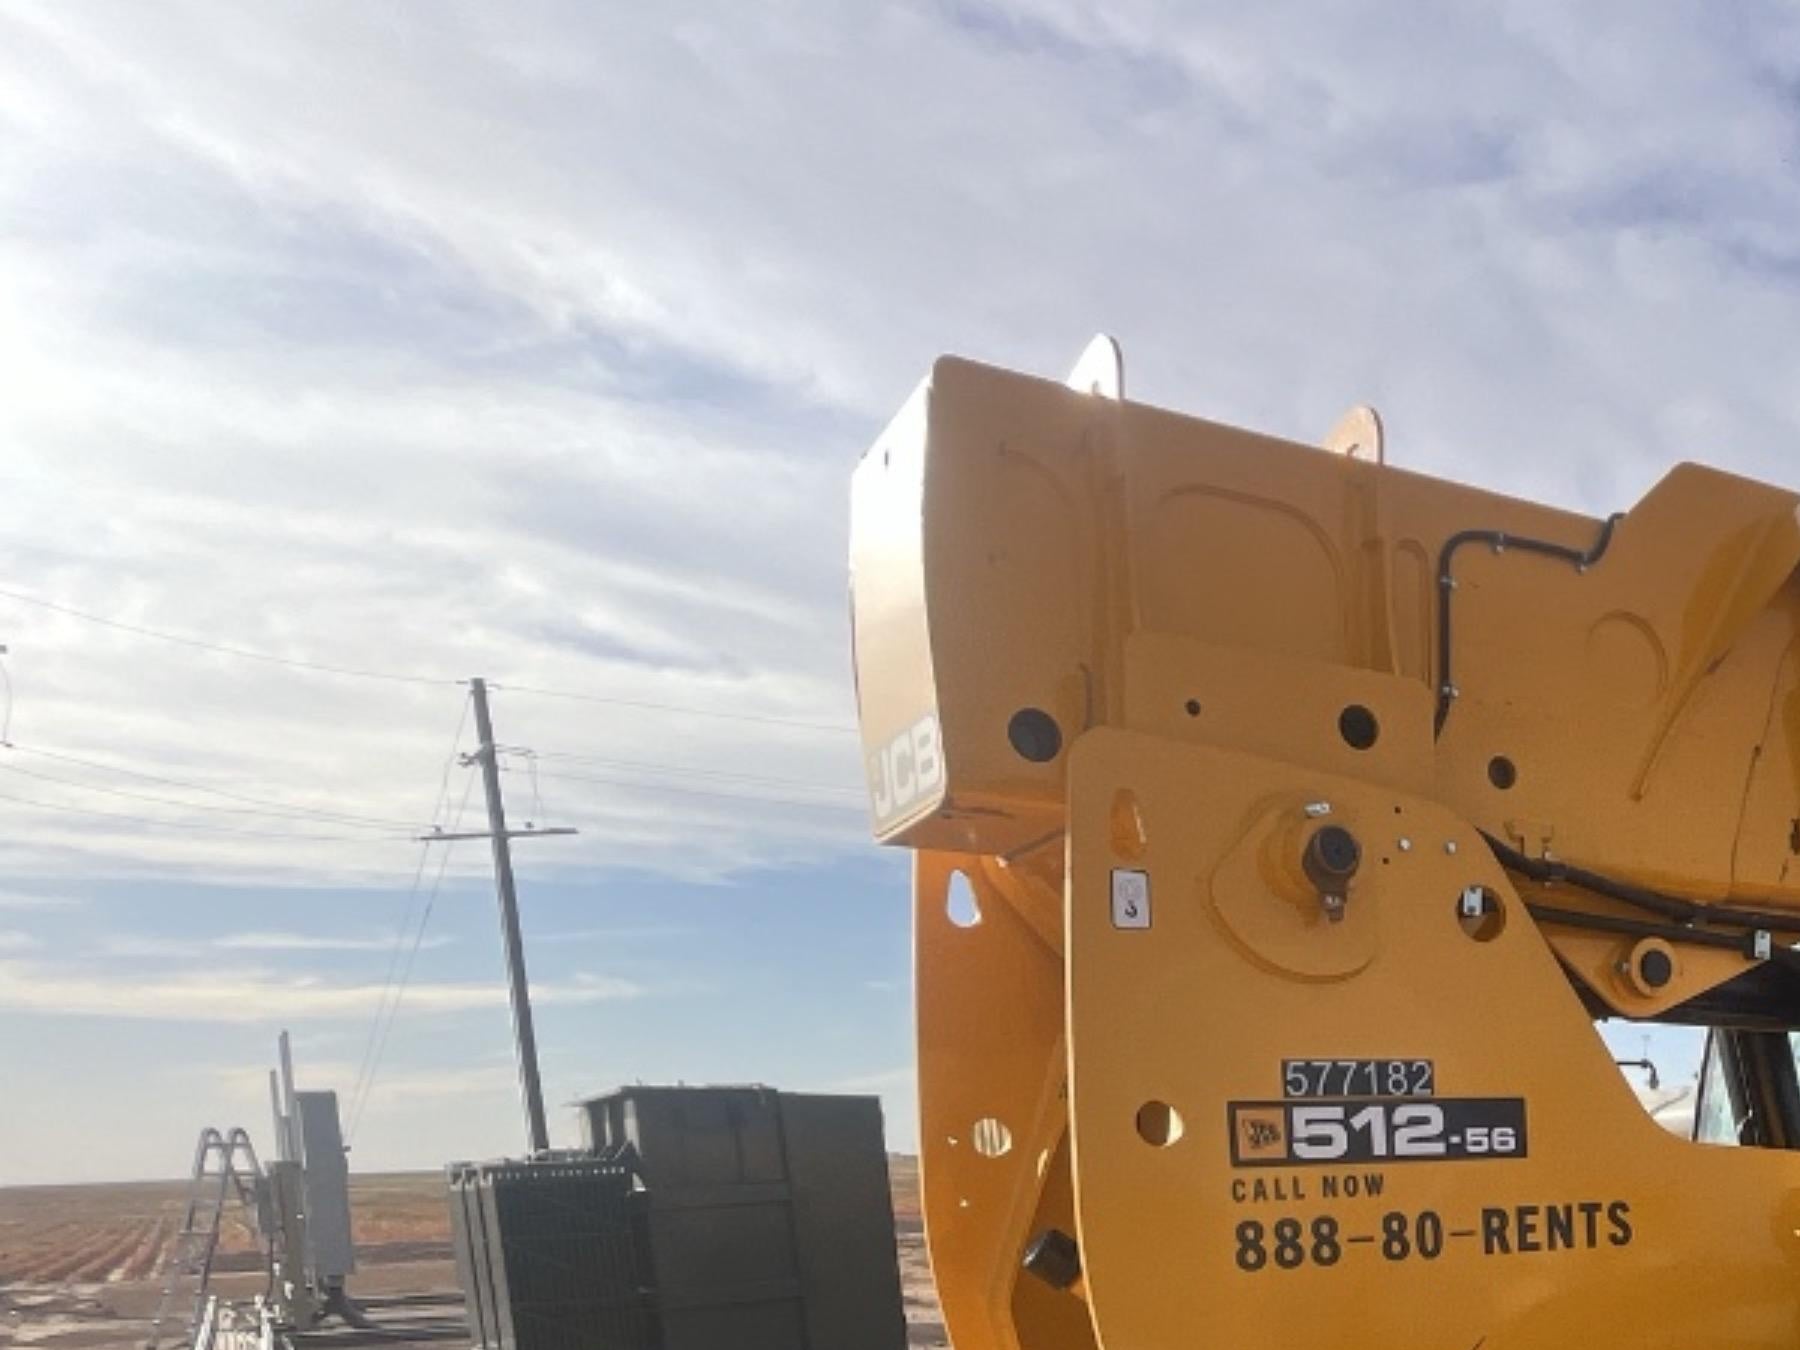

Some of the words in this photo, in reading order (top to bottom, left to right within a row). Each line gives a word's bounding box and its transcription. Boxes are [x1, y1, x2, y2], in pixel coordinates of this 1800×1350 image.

[874, 717, 940, 818] JCB
[1285, 1061, 1432, 1096] 577182
[1291, 1103, 1517, 1160] 512-56
[1232, 1175, 1305, 1202] CALL
[1322, 1173, 1385, 1198] NOW
[1234, 1201, 1633, 1272] 888-80-RENTS
